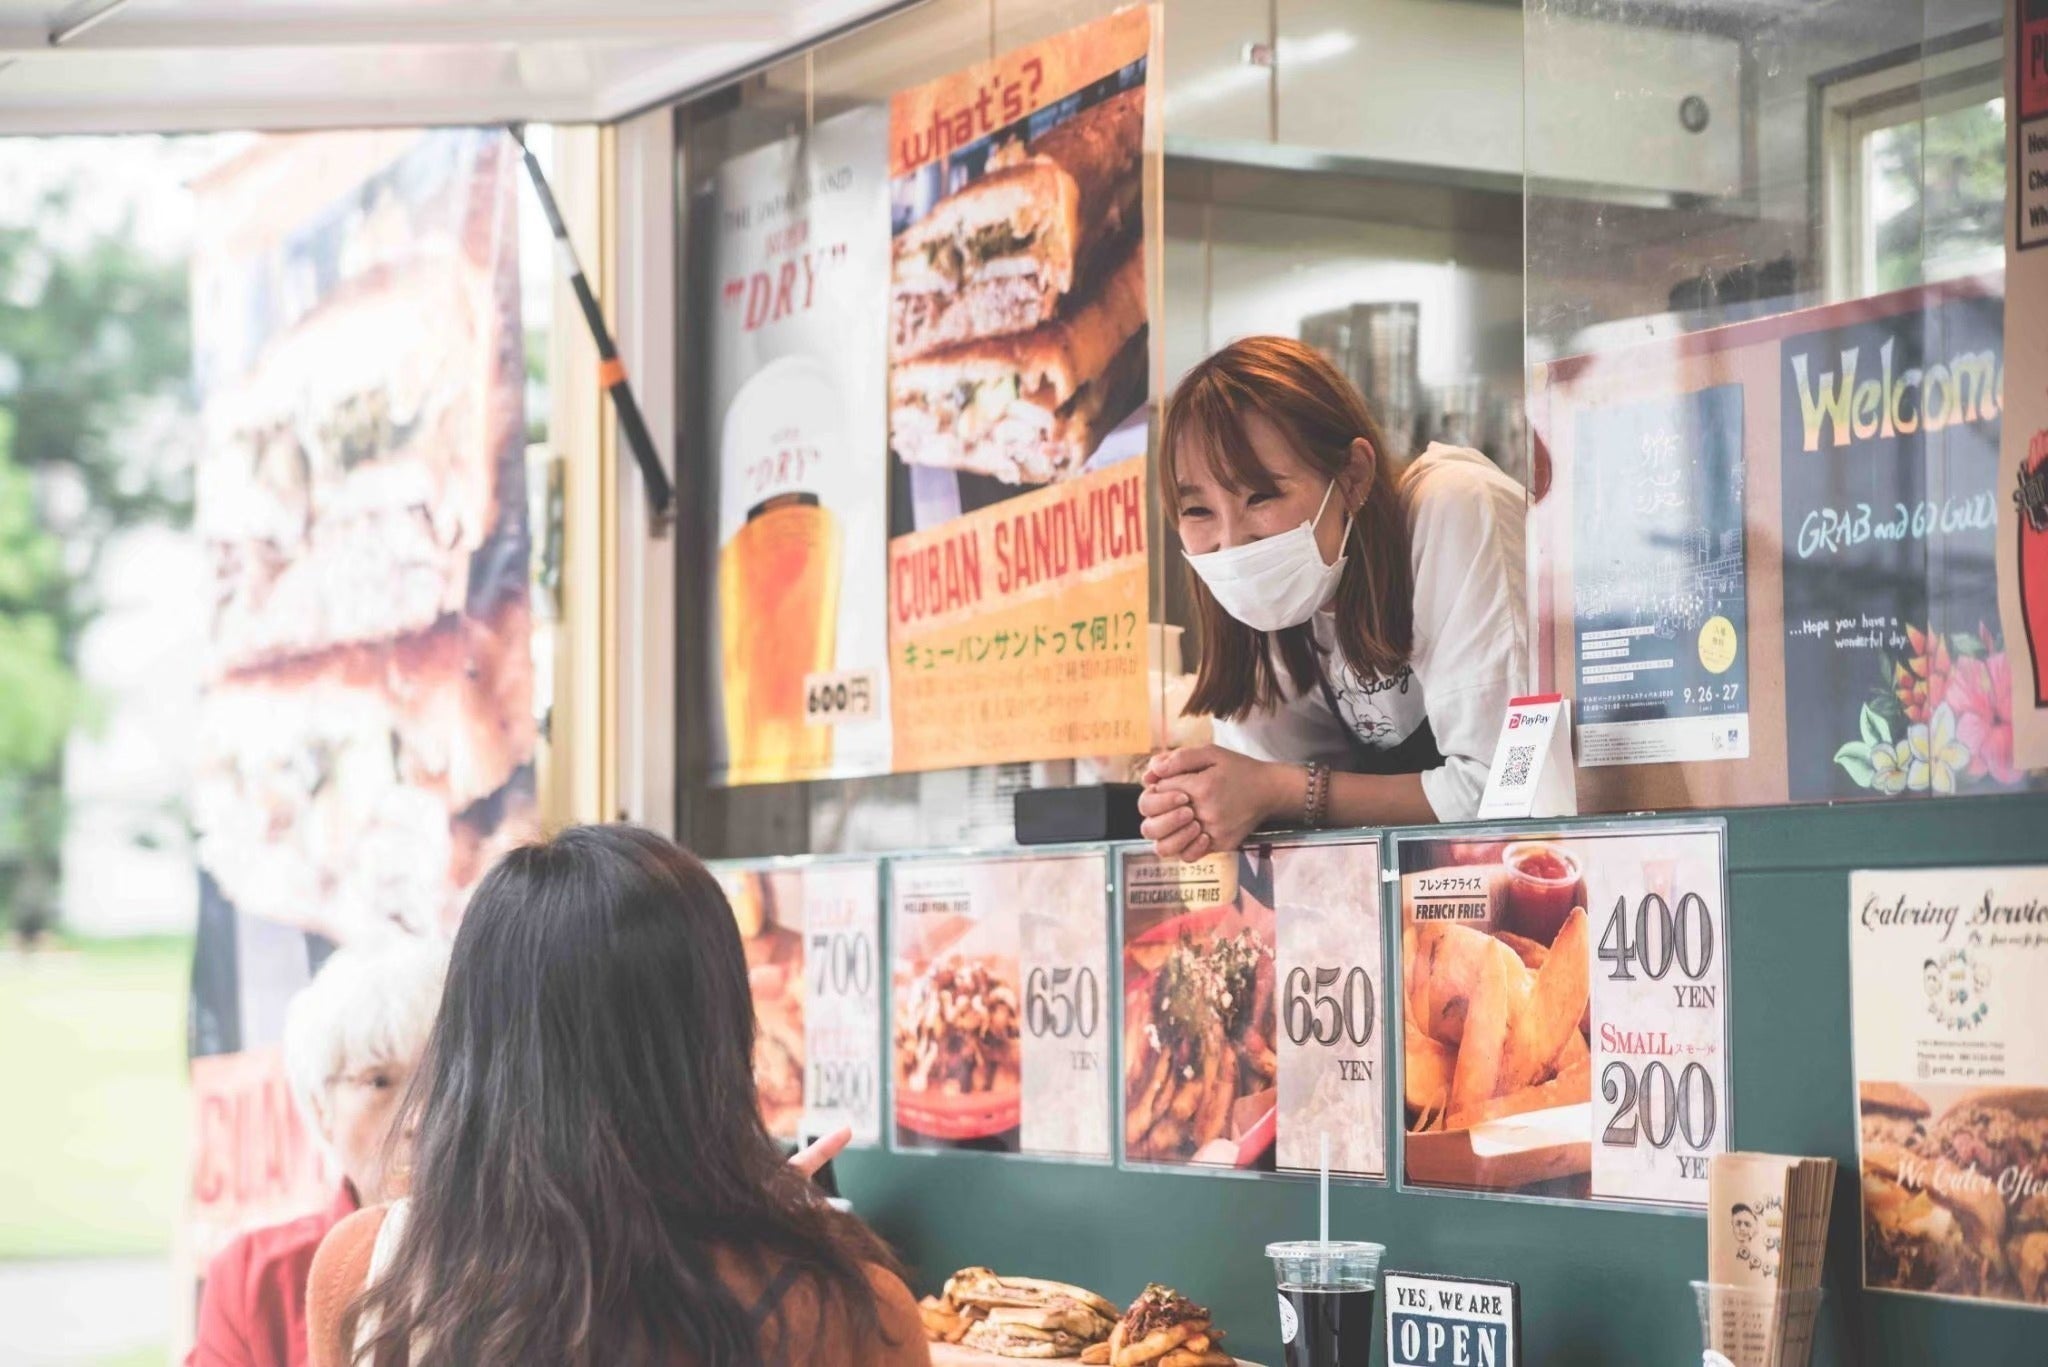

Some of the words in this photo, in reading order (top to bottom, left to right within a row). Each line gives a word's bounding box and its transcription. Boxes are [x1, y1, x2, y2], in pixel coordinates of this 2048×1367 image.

[902, 58, 1044, 168] what's?
[895, 530, 983, 624] CUBAN
[995, 476, 1145, 596] SANDWICH
[1798, 504, 1872, 558] GRAB
[1835, 630, 1883, 649] wonderful
[1836, 619, 1857, 634] you
[1862, 612, 1886, 628] have
[808, 677, 870, 714] 600円
[1520, 713, 1552, 728] PayPay
[1197, 887, 1221, 902] FRIES
[1419, 877, 1482, 892] フレンチフライズ
[1415, 903, 1456, 920] FRENCH
[1457, 903, 1487, 919] FRIES
[1861, 894, 1959, 943] Catering
[1598, 892, 1715, 982] 400
[812, 930, 871, 997] 700
[1026, 966, 1100, 1039] 650
[1283, 966, 1375, 1047] 650
[1673, 985, 1717, 1009] YEN
[1338, 1059, 1375, 1082] YEN
[1601, 1060, 1717, 1151] 200
[1397, 1287, 1432, 1312] YES,
[1438, 1291, 1463, 1305] WE
[1468, 1295, 1502, 1316] ARE
[1401, 1318, 1497, 1367] OPEN
